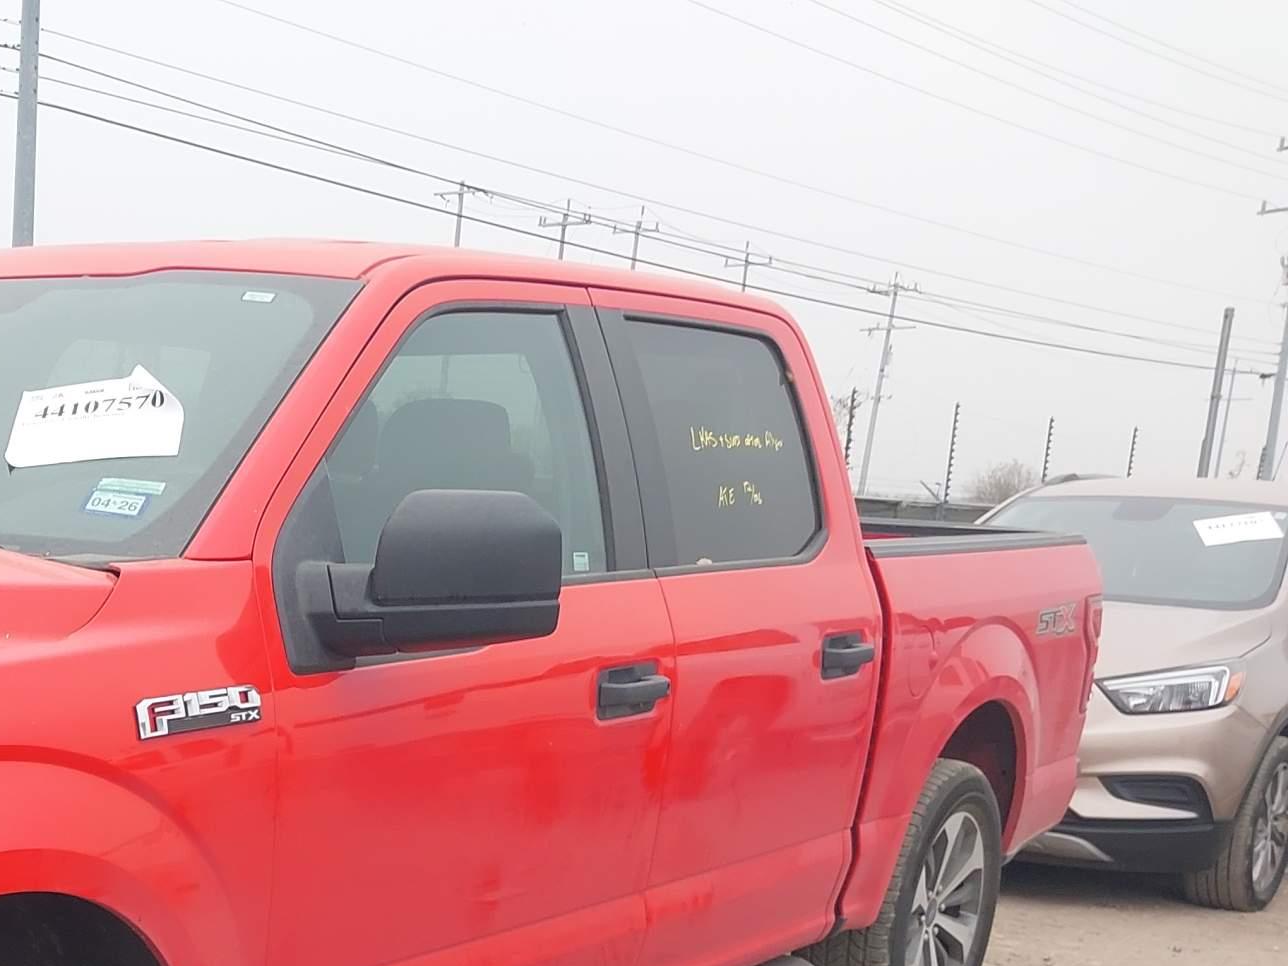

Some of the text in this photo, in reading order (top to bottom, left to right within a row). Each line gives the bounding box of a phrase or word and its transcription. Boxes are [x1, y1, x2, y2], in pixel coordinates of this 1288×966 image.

[35, 389, 165, 418] 44107570
[91, 497, 110, 508] 04
[117, 500, 139, 512] 26
[1036, 602, 1076, 636] STX
[230, 710, 260, 722] STX
